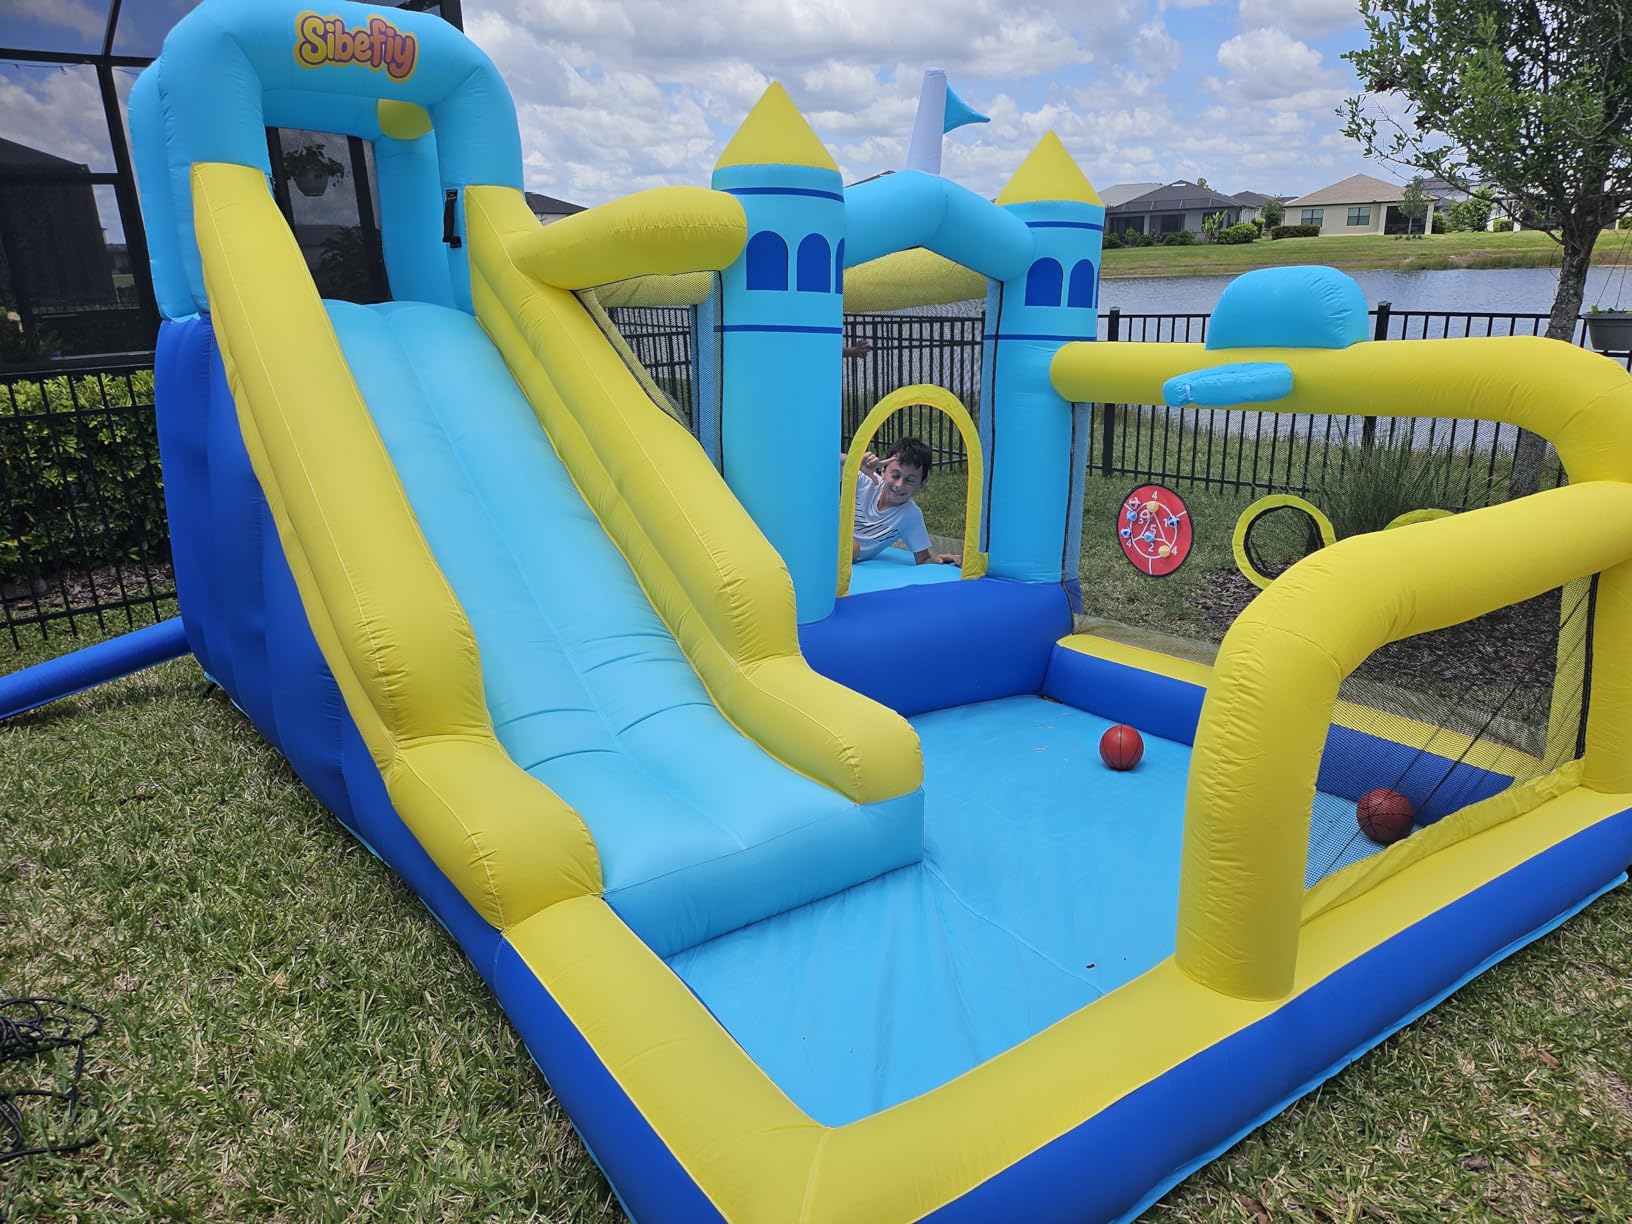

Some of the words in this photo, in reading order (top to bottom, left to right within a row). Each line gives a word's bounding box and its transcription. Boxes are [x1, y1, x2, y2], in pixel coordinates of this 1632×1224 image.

[1151, 490, 1158, 501] 4
[1150, 524, 1157, 536] 5
[1126, 539, 1132, 548] 4
[1148, 542, 1154, 552] 2
[1171, 546, 1178, 556] 4
